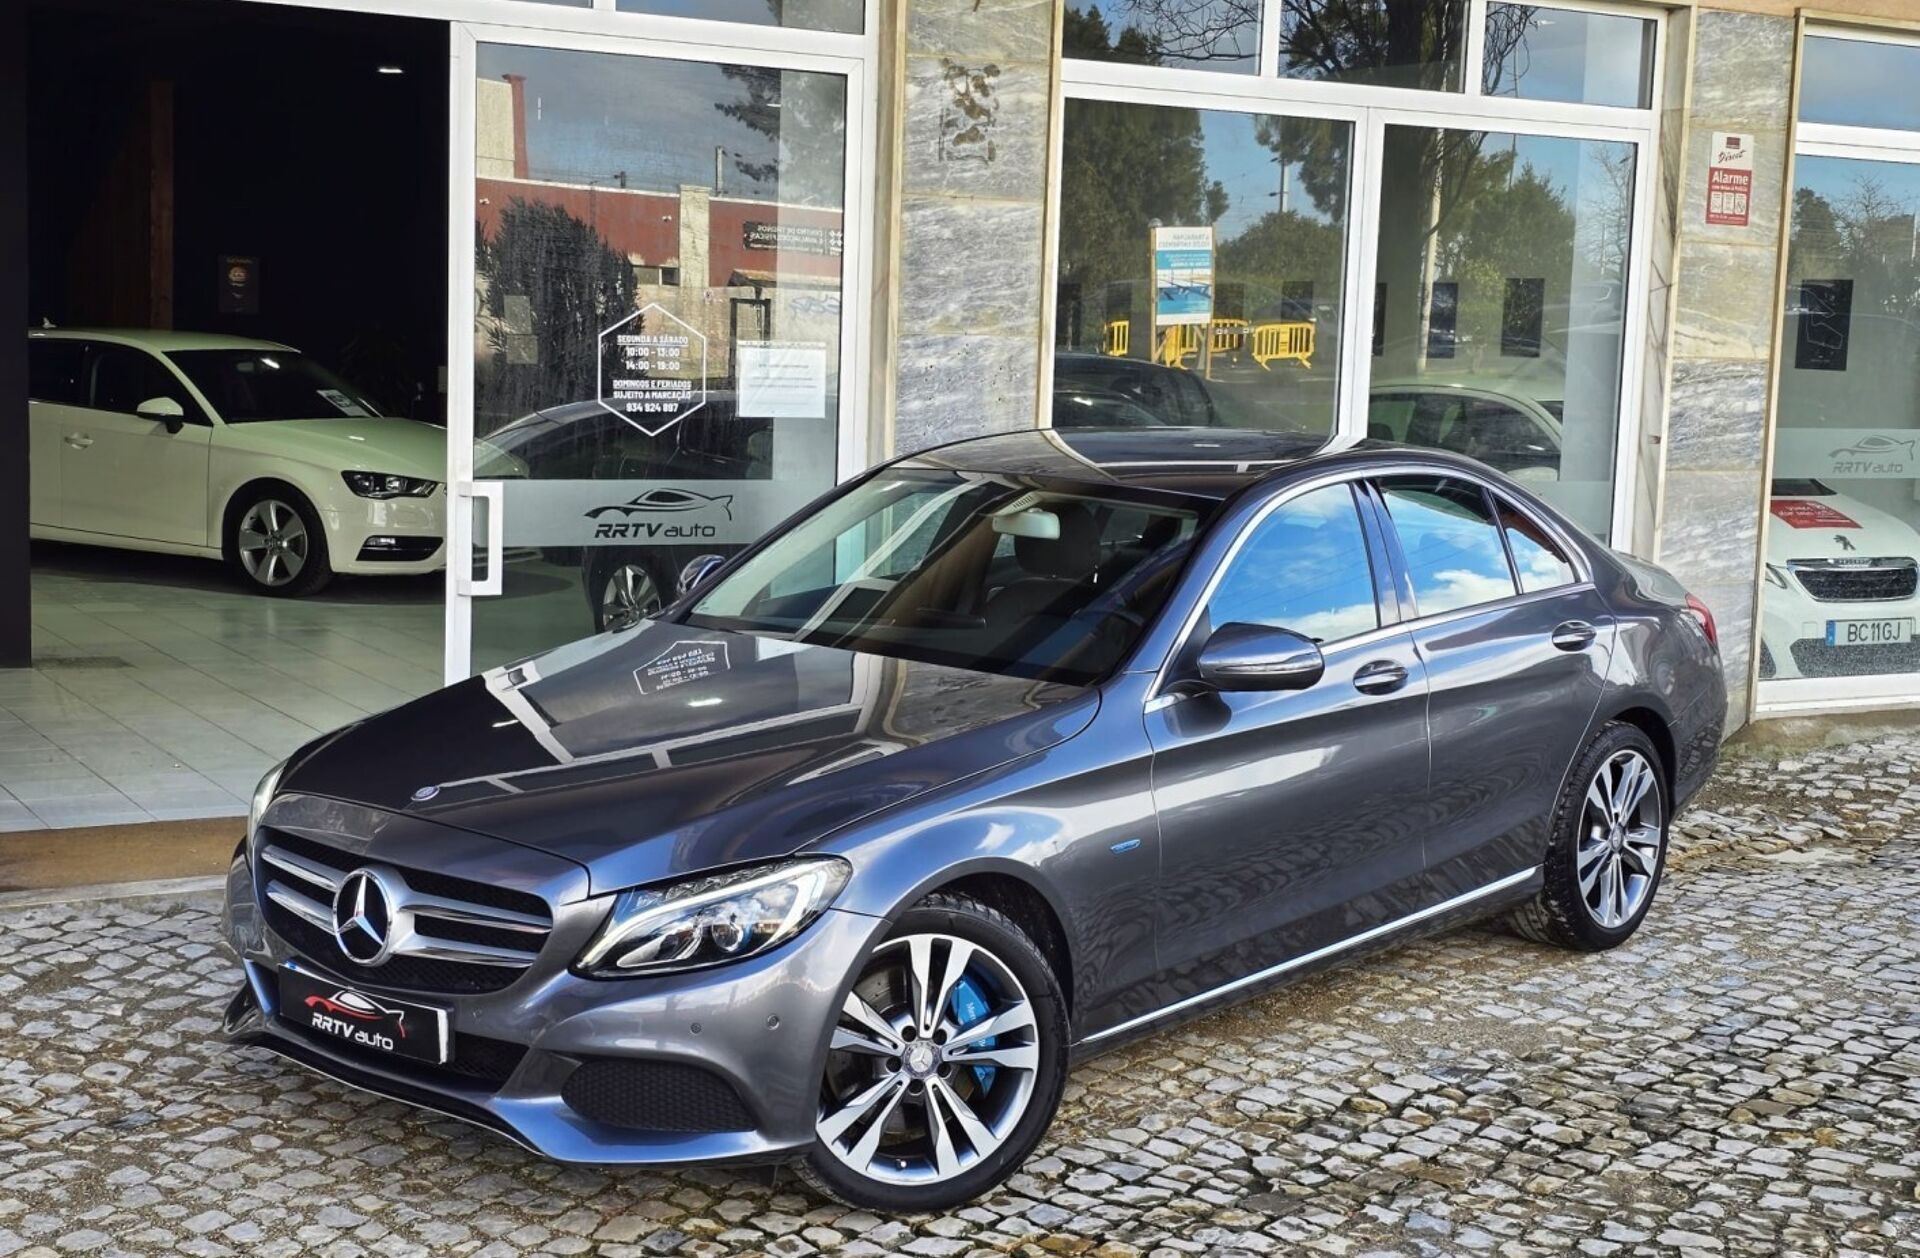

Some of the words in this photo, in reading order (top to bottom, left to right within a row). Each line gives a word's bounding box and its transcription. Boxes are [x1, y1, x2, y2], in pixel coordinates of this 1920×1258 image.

[1712, 171, 1748, 185] Alarme
[617, 335, 652, 344] SEGUNDA
[659, 334, 688, 345] SÁBADO
[626, 347, 649, 356] 10:00
[657, 348, 680, 357] 13:00
[626, 361, 649, 370] 14:00
[613, 380, 649, 389] DOMINGOS
[657, 380, 691, 390] FERIADOS
[613, 390, 643, 399] SUJEITO
[645, 391, 650, 399] A
[652, 390, 691, 401] MARCAÇÃO
[594, 523, 663, 538] RRTV
[664, 523, 715, 537] auto
[311, 1012, 354, 1037] RRTV
[355, 1032, 394, 1050] auto
